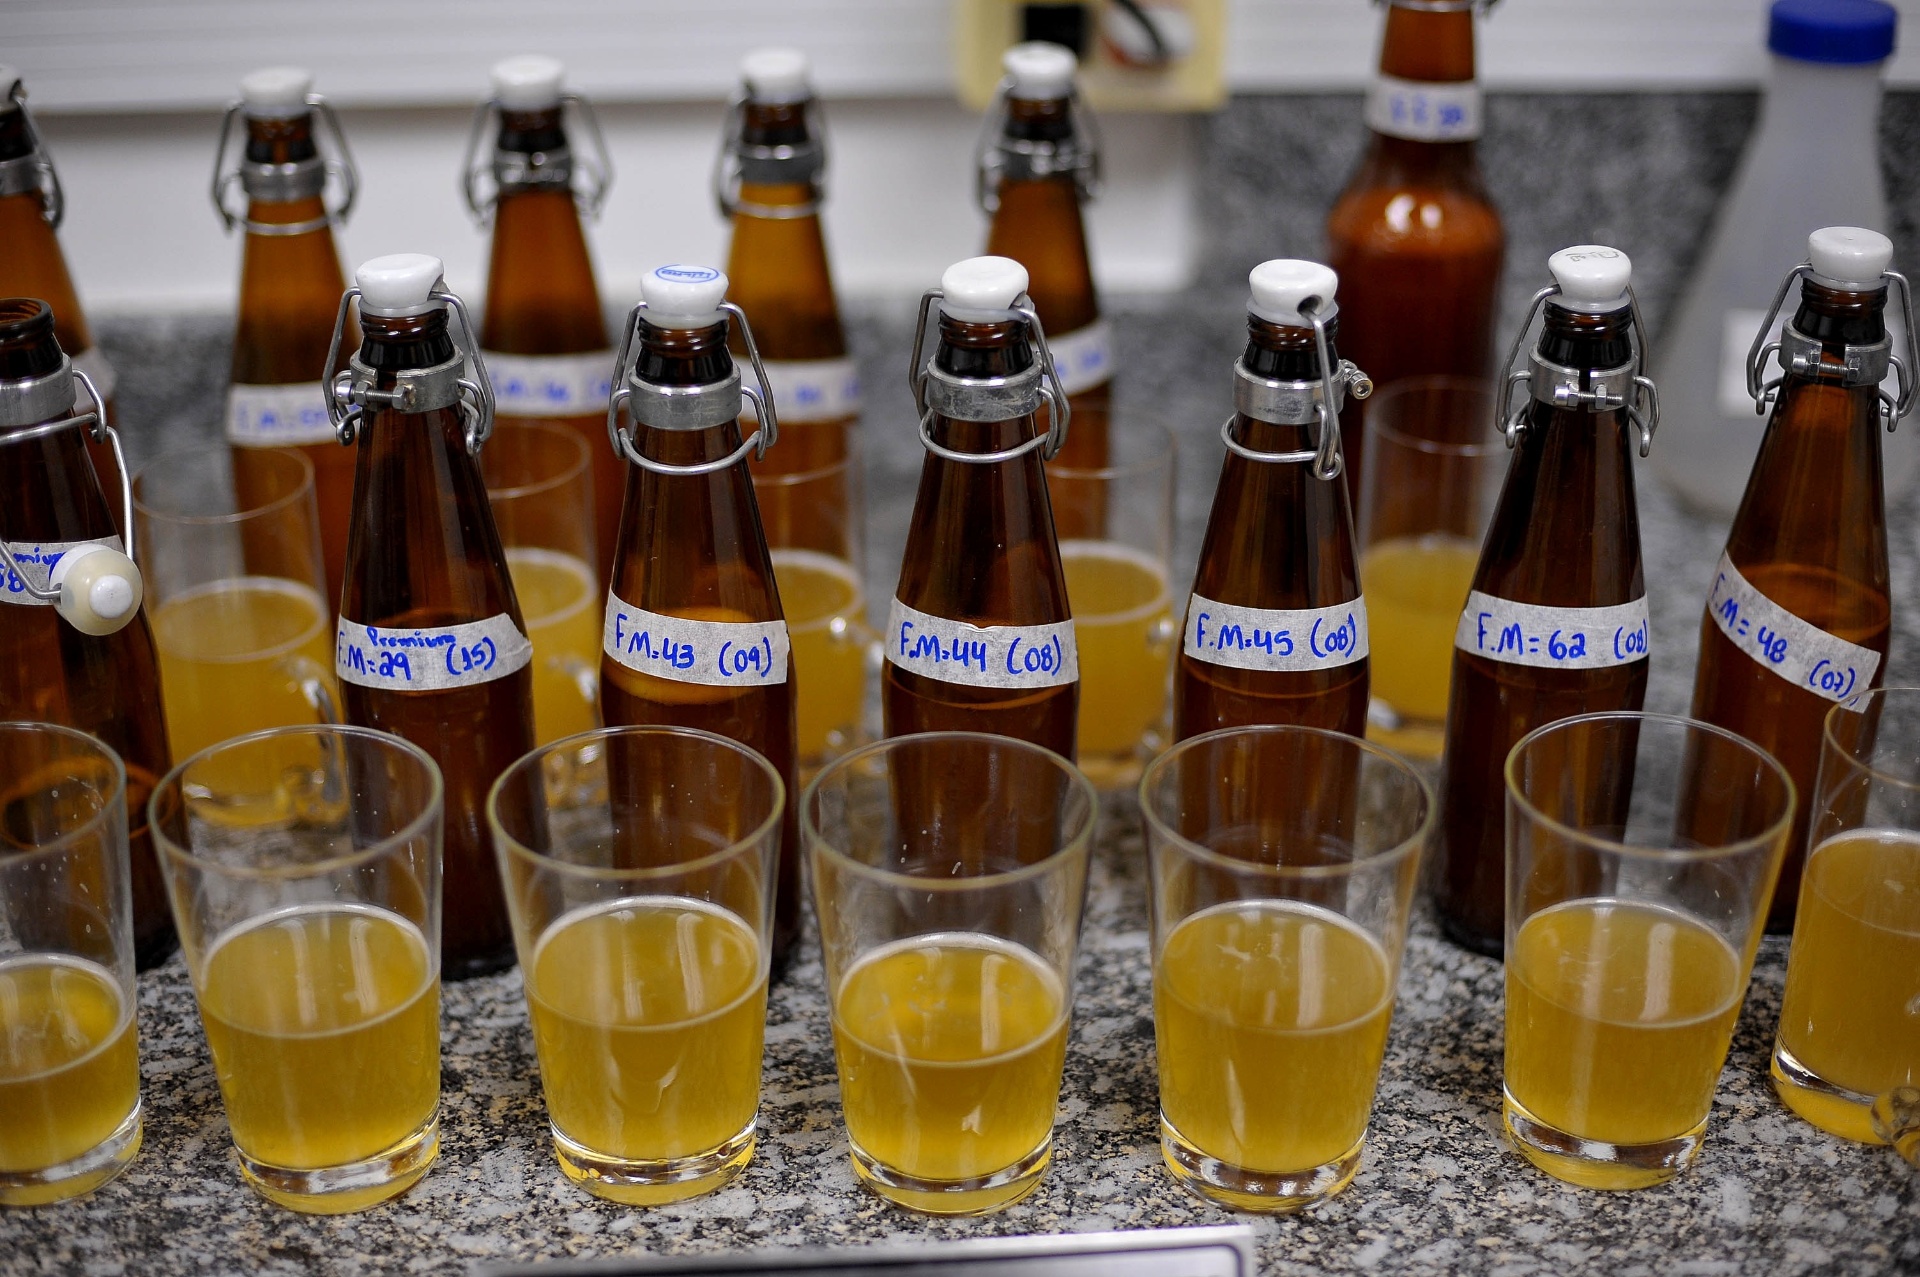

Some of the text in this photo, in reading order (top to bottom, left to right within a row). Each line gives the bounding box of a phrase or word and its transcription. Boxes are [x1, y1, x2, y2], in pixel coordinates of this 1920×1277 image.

[366, 626, 456, 648] Premium
[446, 636, 496, 675] (15)
[1006, 633, 1062, 676] (08)
[1310, 612, 1357, 658] (08)
[1613, 618, 1648, 660] (08)
[718, 636, 773, 678] (09)
